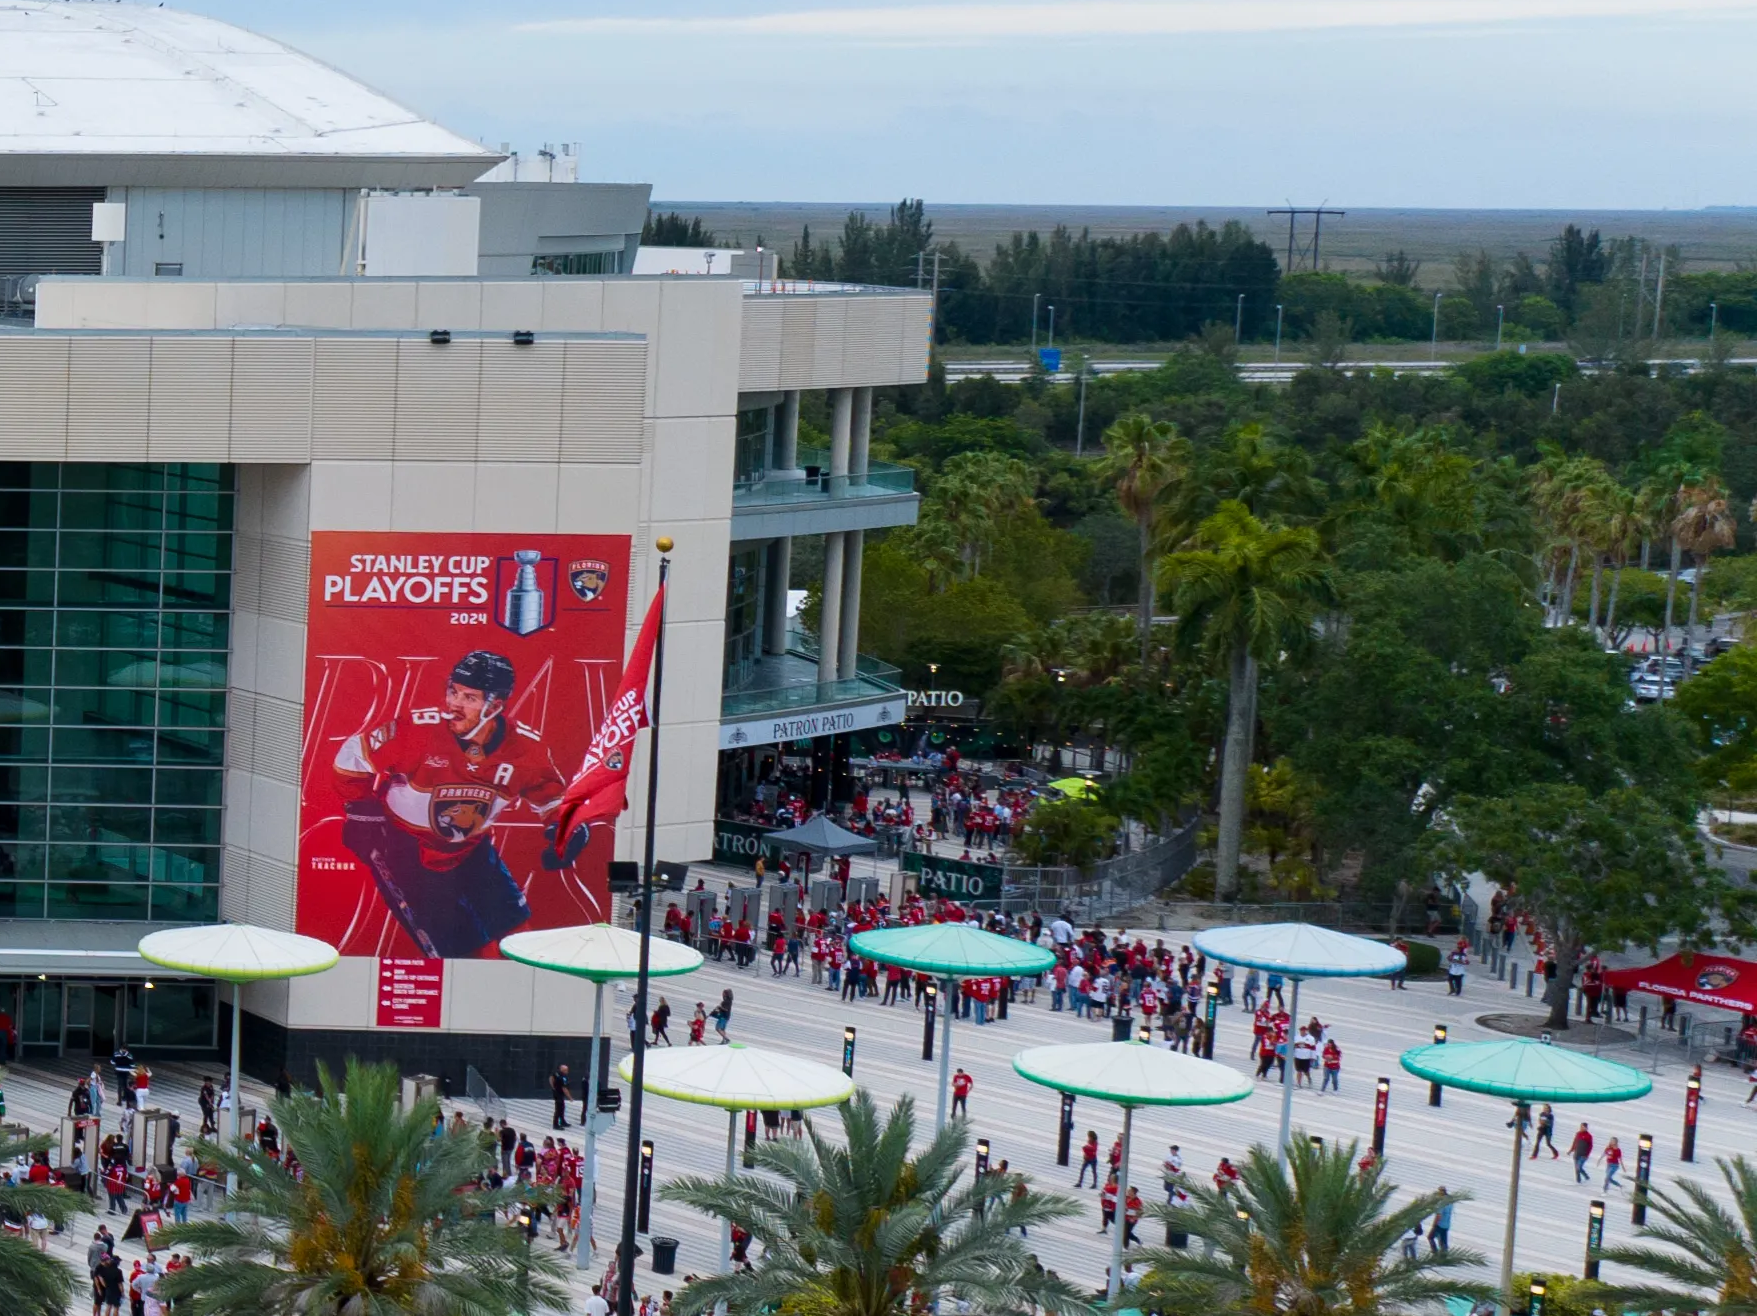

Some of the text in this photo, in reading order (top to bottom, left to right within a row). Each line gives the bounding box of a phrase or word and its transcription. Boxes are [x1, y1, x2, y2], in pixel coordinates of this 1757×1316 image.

[350, 554, 489, 574] STANLEY CUP
[324, 574, 488, 604] PLAYOFFS
[450, 612, 487, 625] 2024
[906, 690, 963, 707] PATIO
[822, 712, 854, 731] PATIO
[920, 866, 984, 896] PATIO
[1638, 982, 1754, 1010] FLORIDA PANTHERS
